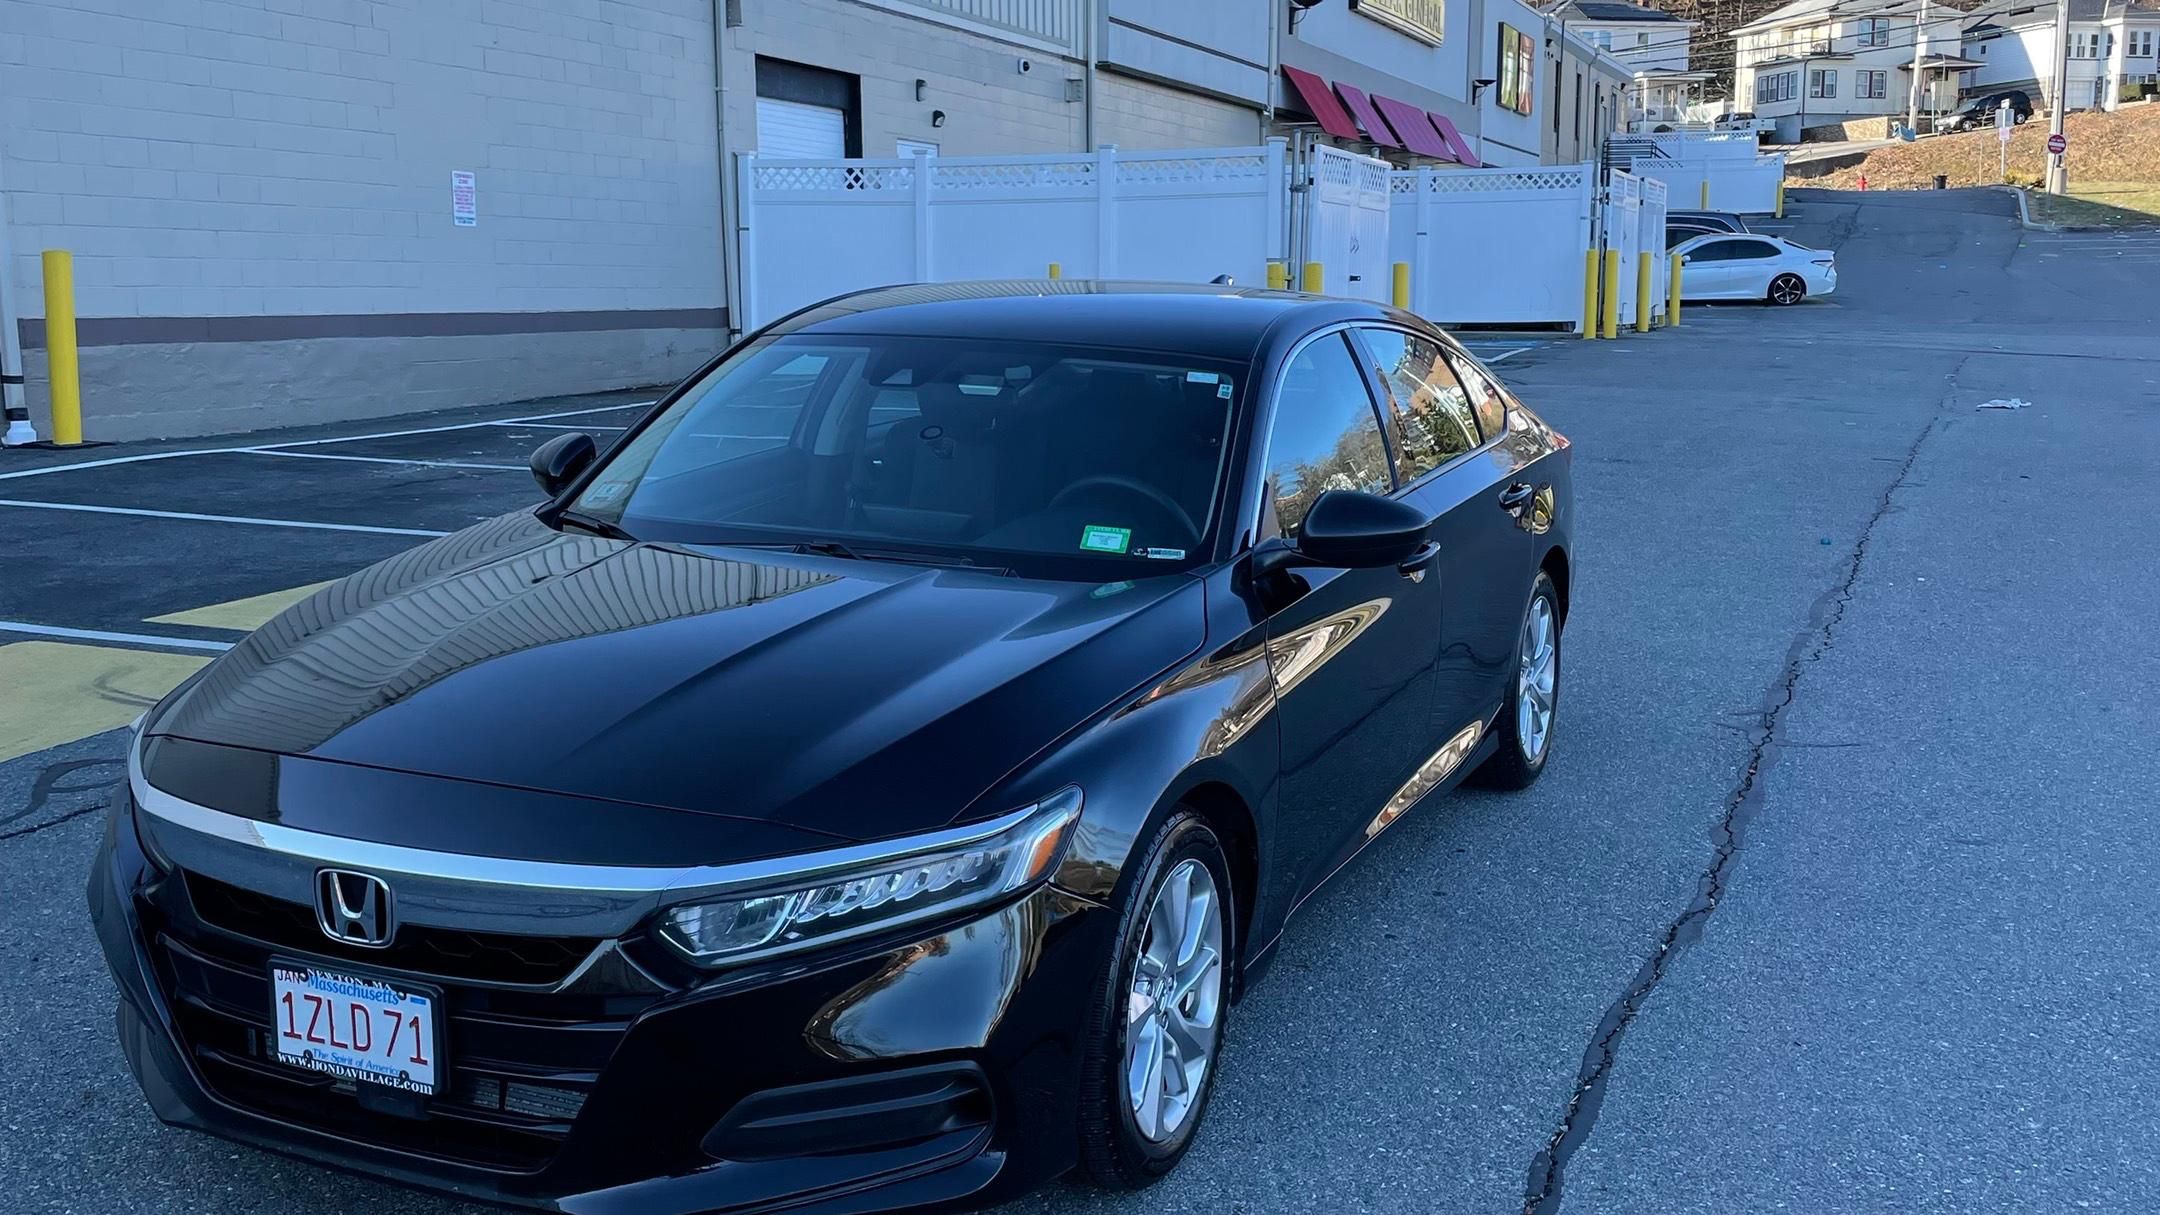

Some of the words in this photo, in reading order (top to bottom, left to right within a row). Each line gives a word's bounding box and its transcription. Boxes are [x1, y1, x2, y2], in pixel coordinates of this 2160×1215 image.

[307, 975, 400, 1006] Massachusetts
[282, 991, 372, 1052] 1ZLD
[383, 1009, 429, 1066] 71
[312, 1048, 329, 1060] The
[331, 1052, 353, 1066] Spirit
[355, 1059, 364, 1067] of
